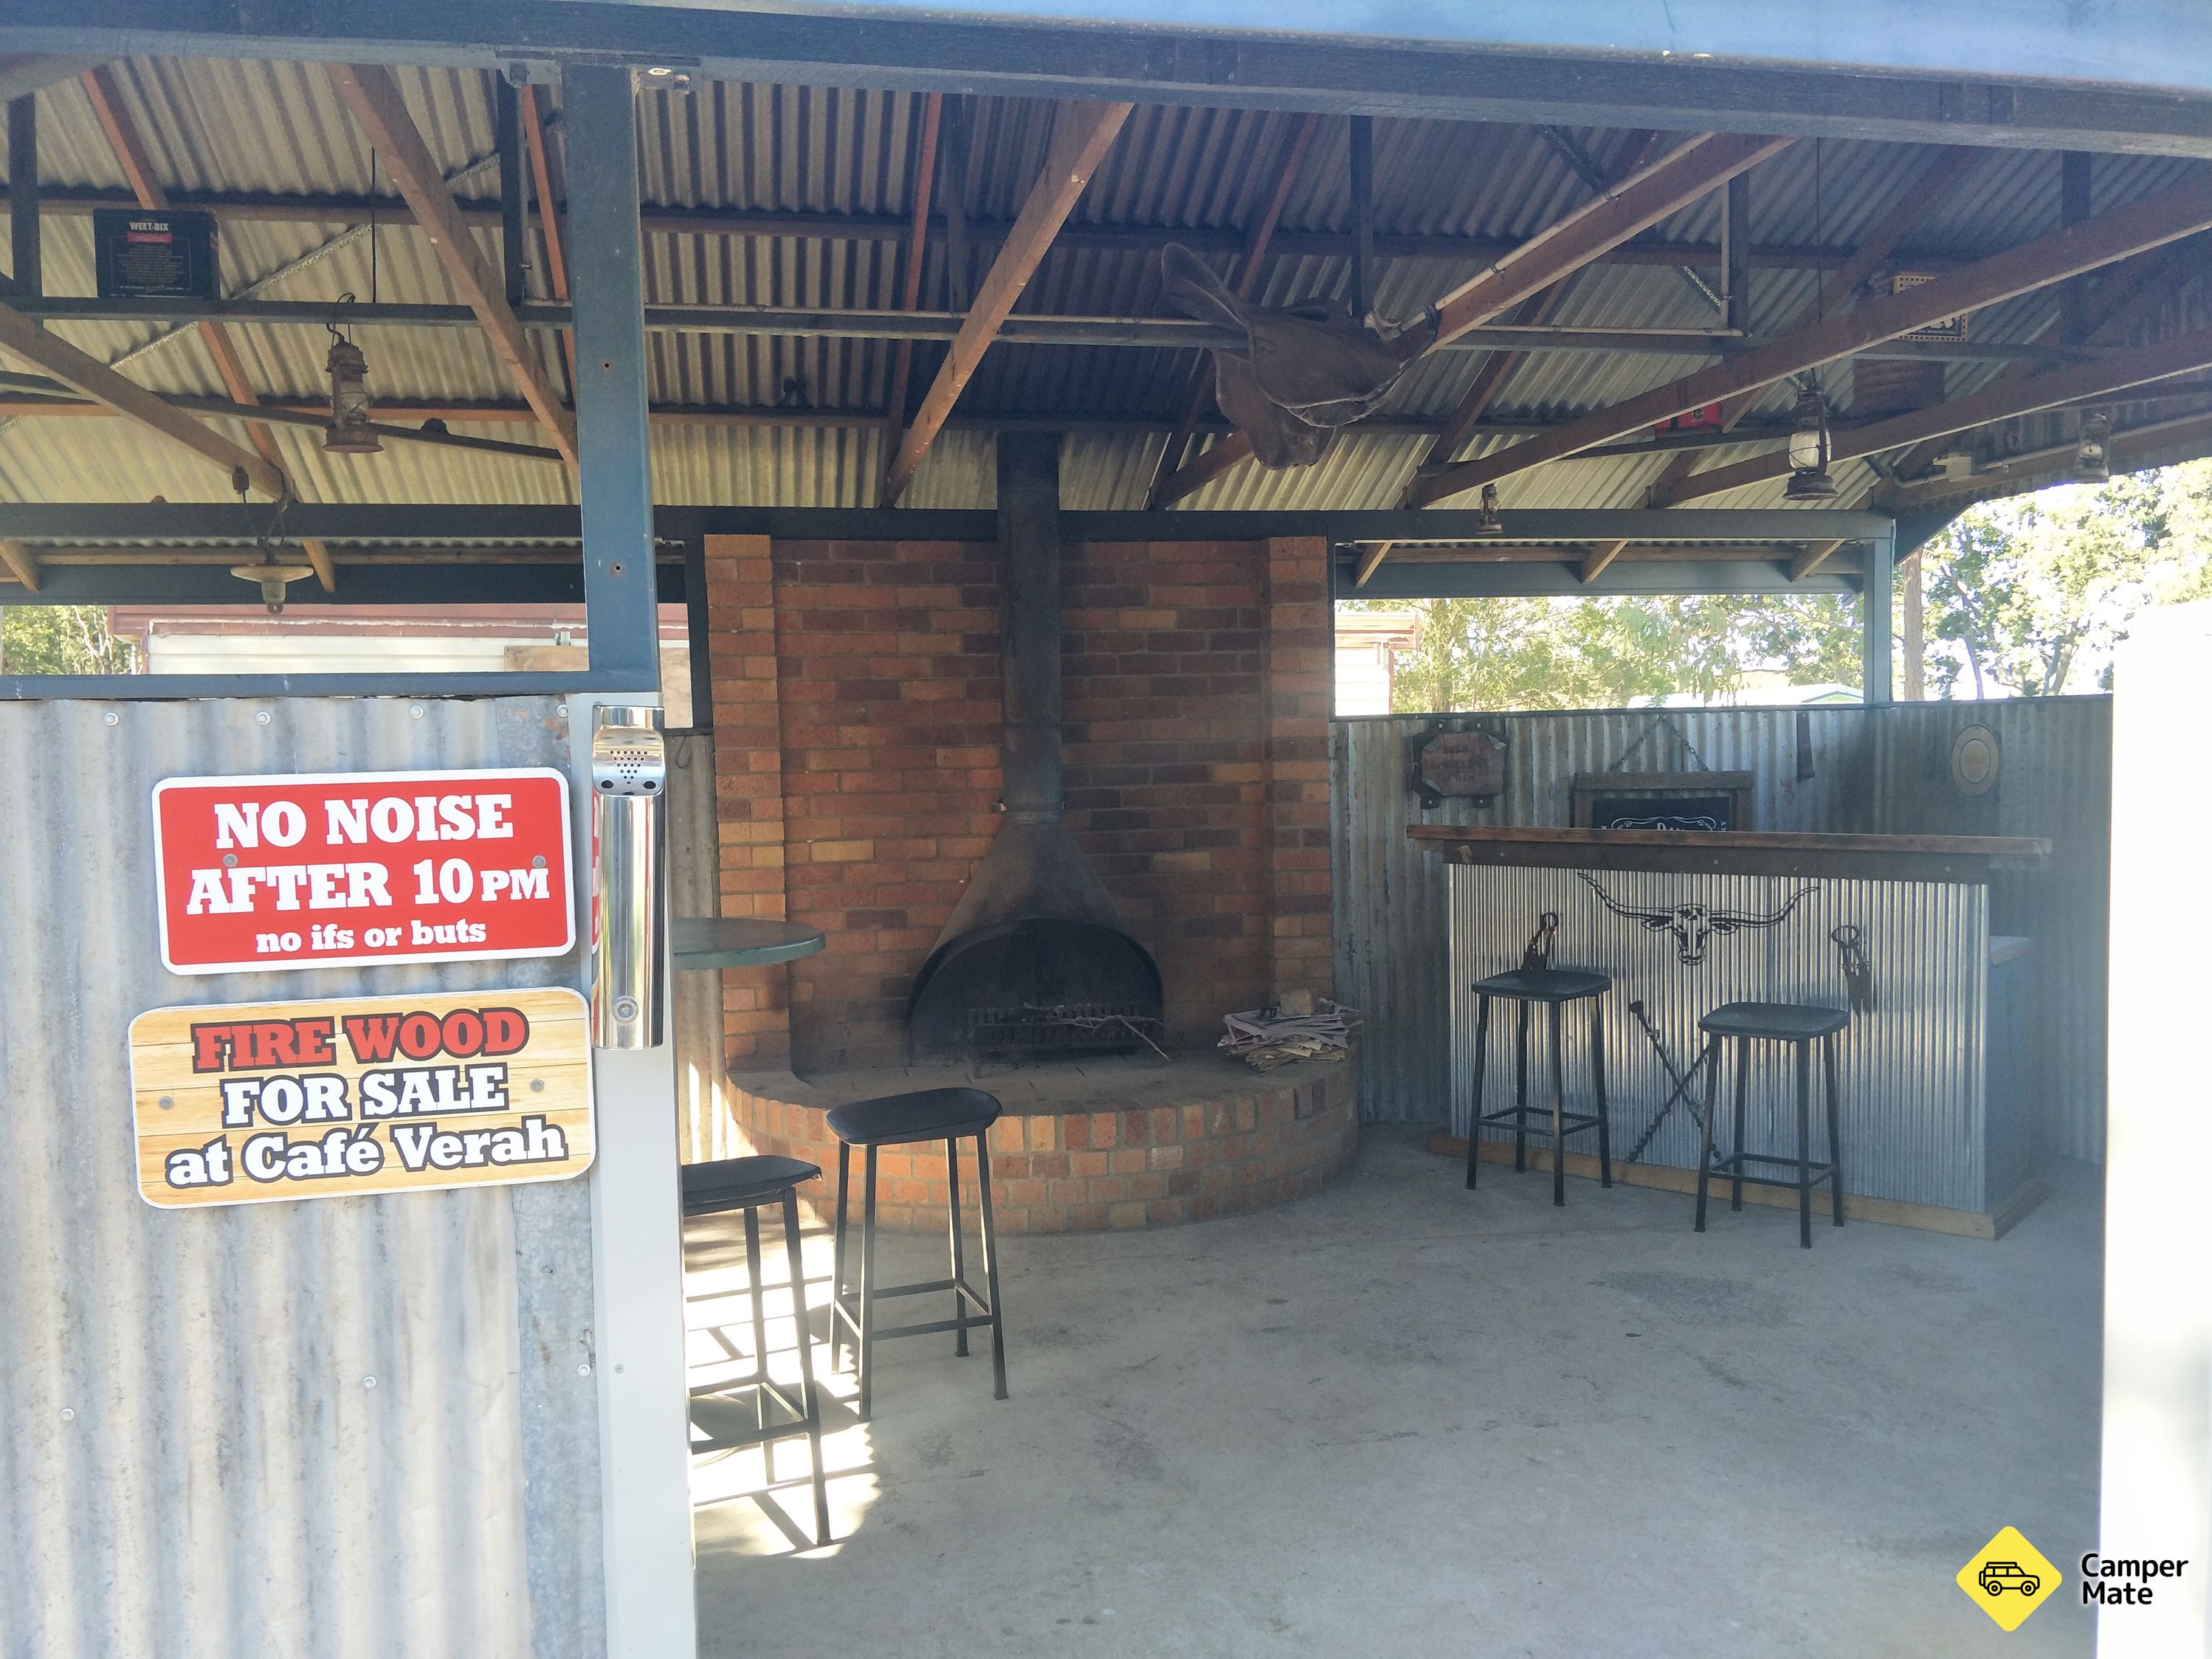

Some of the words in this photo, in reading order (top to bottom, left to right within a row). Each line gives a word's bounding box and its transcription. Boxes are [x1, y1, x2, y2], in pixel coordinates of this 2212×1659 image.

[129, 222, 170, 231] WEET-BIX
[214, 801, 306, 849] NO
[325, 794, 513, 844] NOISE
[187, 862, 393, 914] AFTER
[413, 858, 473, 904] 10
[480, 869, 549, 901] PM
[256, 932, 302, 953] no
[311, 924, 354, 950] ifs
[364, 927, 402, 948] or
[411, 919, 486, 945] buts
[190, 1016, 337, 1074] FIRE
[342, 1007, 529, 1063] WOOD
[220, 1073, 352, 1128] FOR
[359, 1062, 509, 1120] SALE
[165, 1134, 233, 1189] at
[241, 1122, 385, 1183] Café
[390, 1114, 568, 1172] Verah
